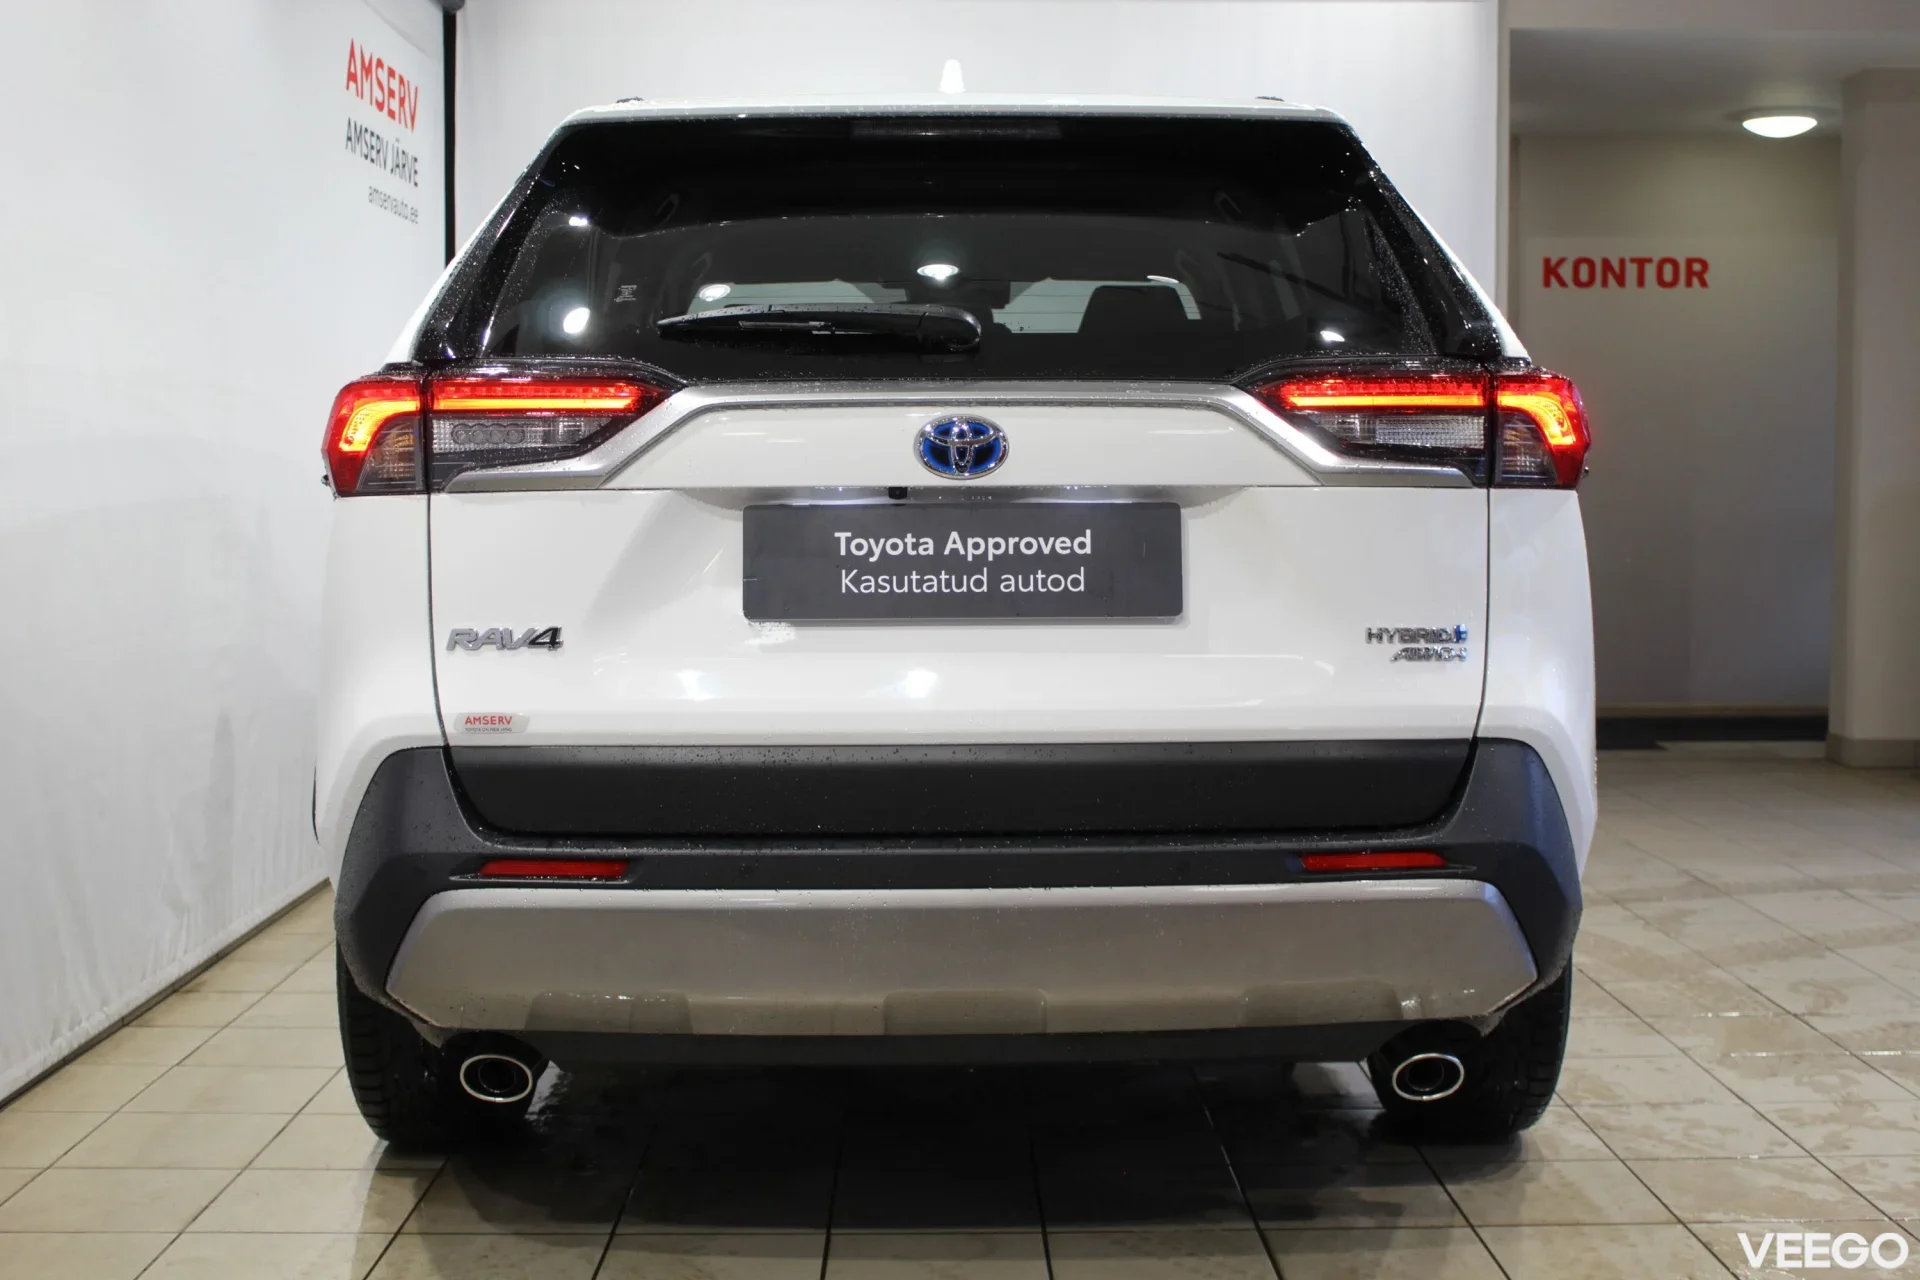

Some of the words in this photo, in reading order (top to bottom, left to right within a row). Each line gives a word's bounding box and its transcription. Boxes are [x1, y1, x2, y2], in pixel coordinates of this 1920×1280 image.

[345, 37, 419, 134] AMSERV
[345, 116, 389, 170] AMSERV
[390, 138, 418, 187] JÄRVE
[1542, 256, 1710, 289] KONTOR
[834, 532, 934, 562] Toyota
[944, 529, 1092, 561] Approved
[841, 567, 988, 593] Kasutatud
[1000, 566, 1085, 592] autod
[446, 626, 564, 651] RAV4
[1365, 627, 1453, 643] HYBRID
[465, 716, 512, 725] AMSERV
